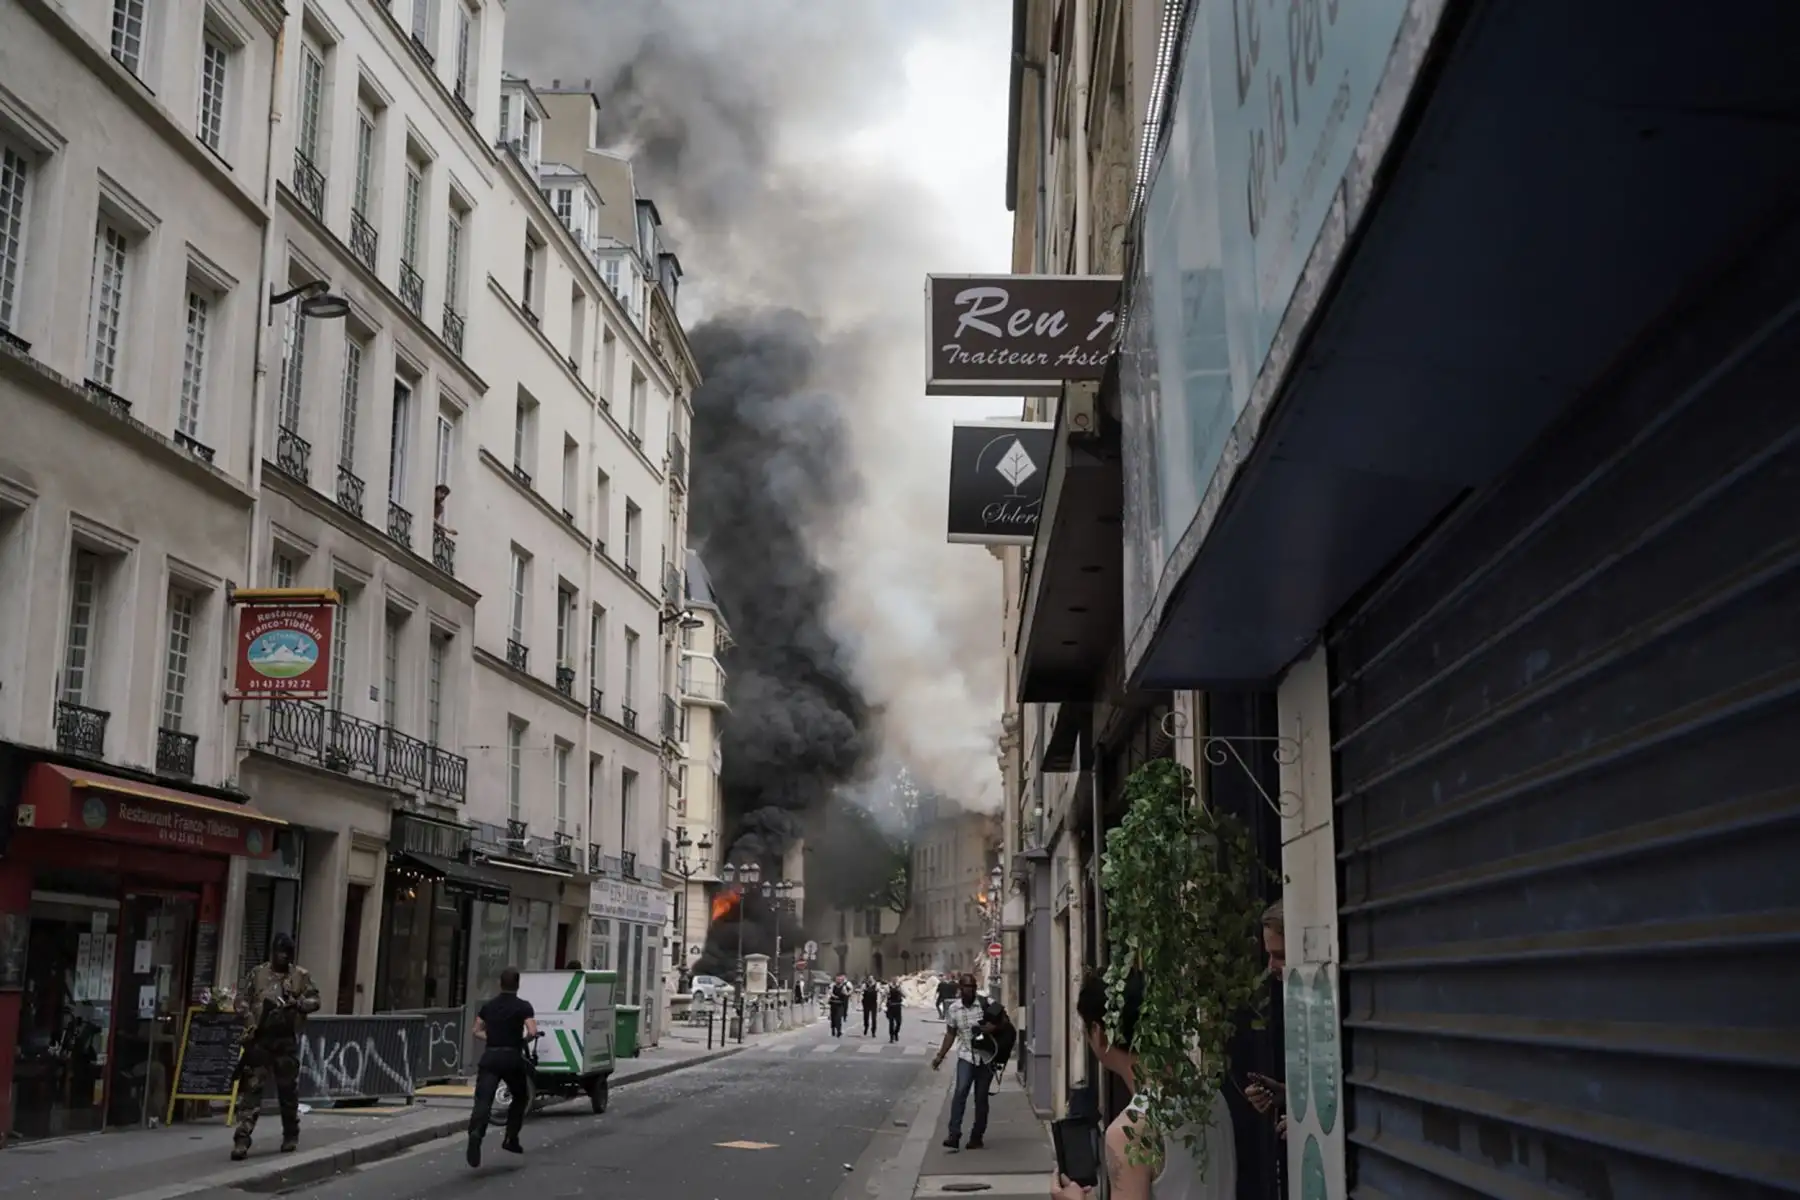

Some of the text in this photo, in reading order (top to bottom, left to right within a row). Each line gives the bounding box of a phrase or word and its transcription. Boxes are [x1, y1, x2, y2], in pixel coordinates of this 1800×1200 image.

[954, 286, 1068, 338] Ren
[942, 343, 1049, 365] Traiteur
[257, 610, 314, 622] Restaurant
[249, 680, 259, 688] 01
[262, 680, 272, 688] 43
[119, 803, 172, 828] Restaurant
